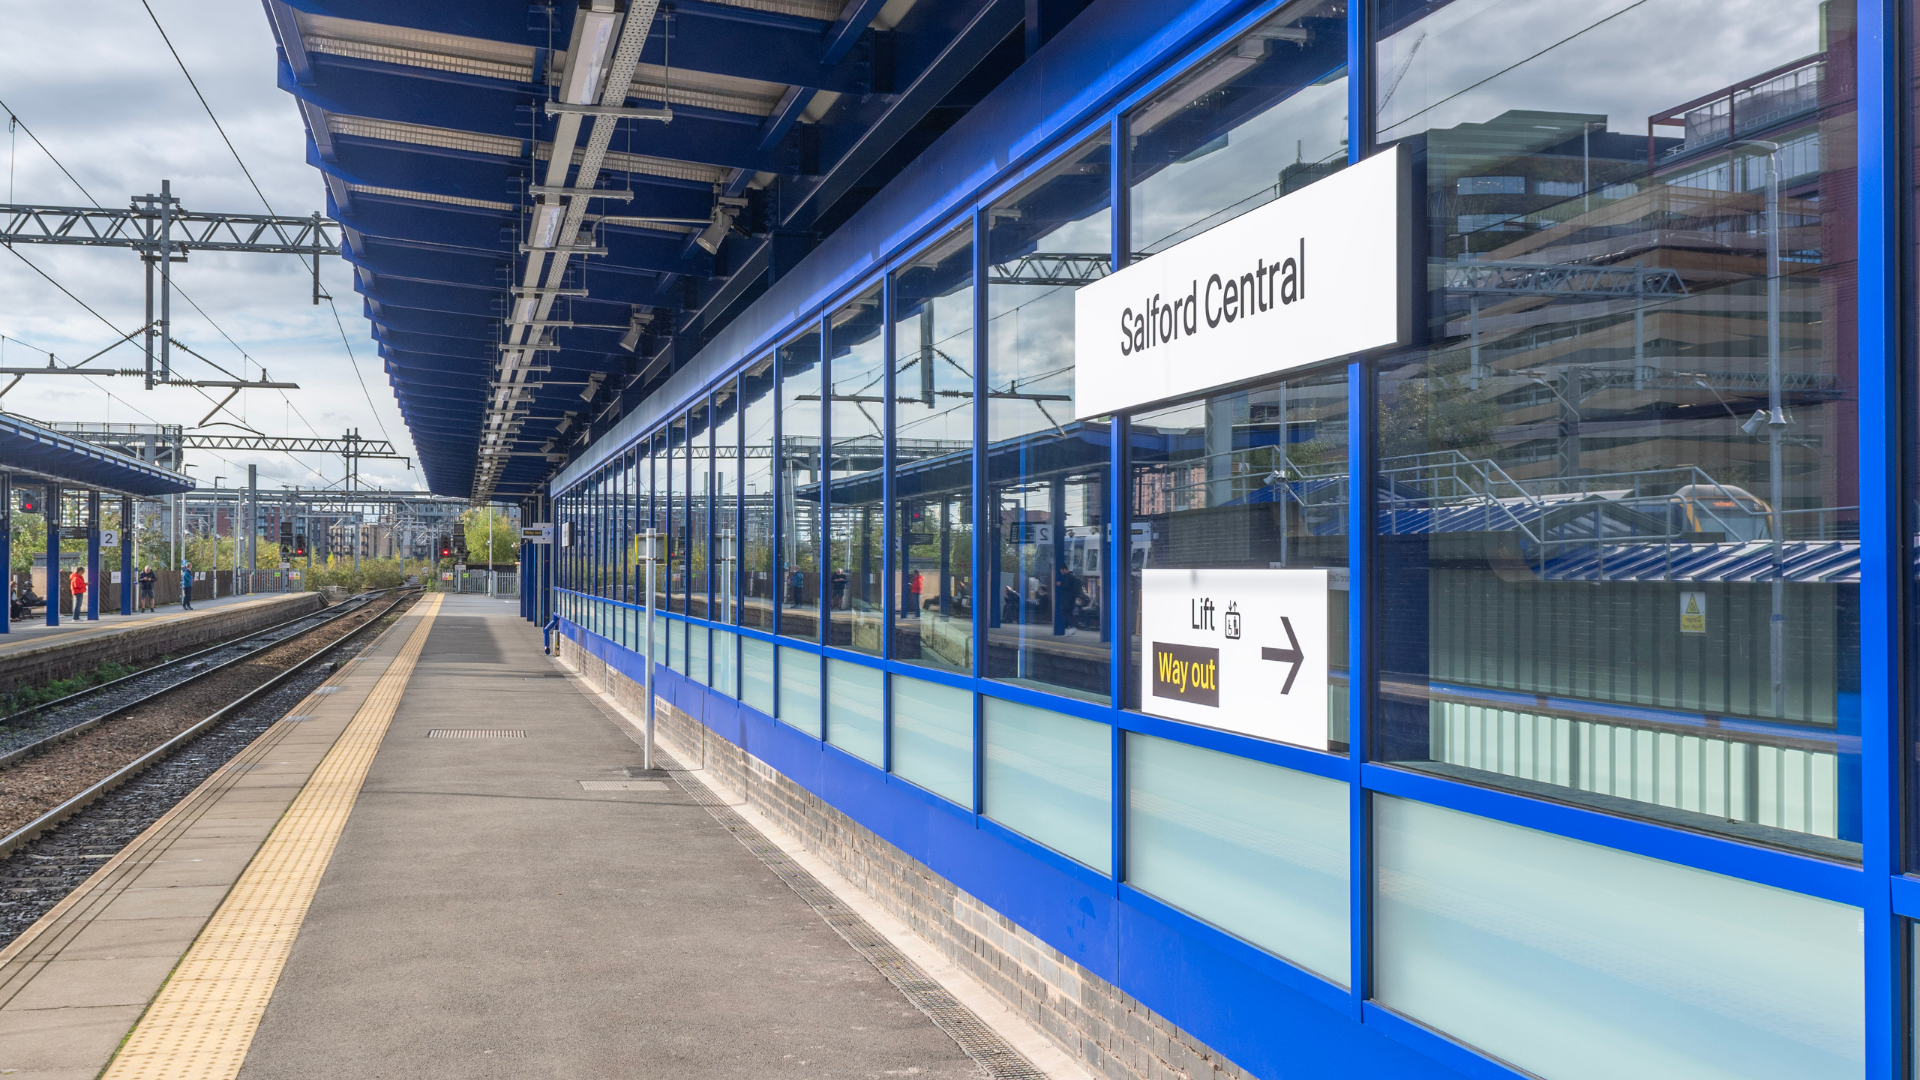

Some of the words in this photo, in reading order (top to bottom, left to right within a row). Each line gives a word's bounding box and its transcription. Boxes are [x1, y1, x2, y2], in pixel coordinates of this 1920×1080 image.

[1120, 279, 1197, 357] Salford
[1205, 237, 1305, 329] Central
[105, 533, 113, 543] 2
[1191, 597, 1215, 631] Lift
[1158, 651, 1189, 694] Way
[1191, 658, 1216, 691] out
